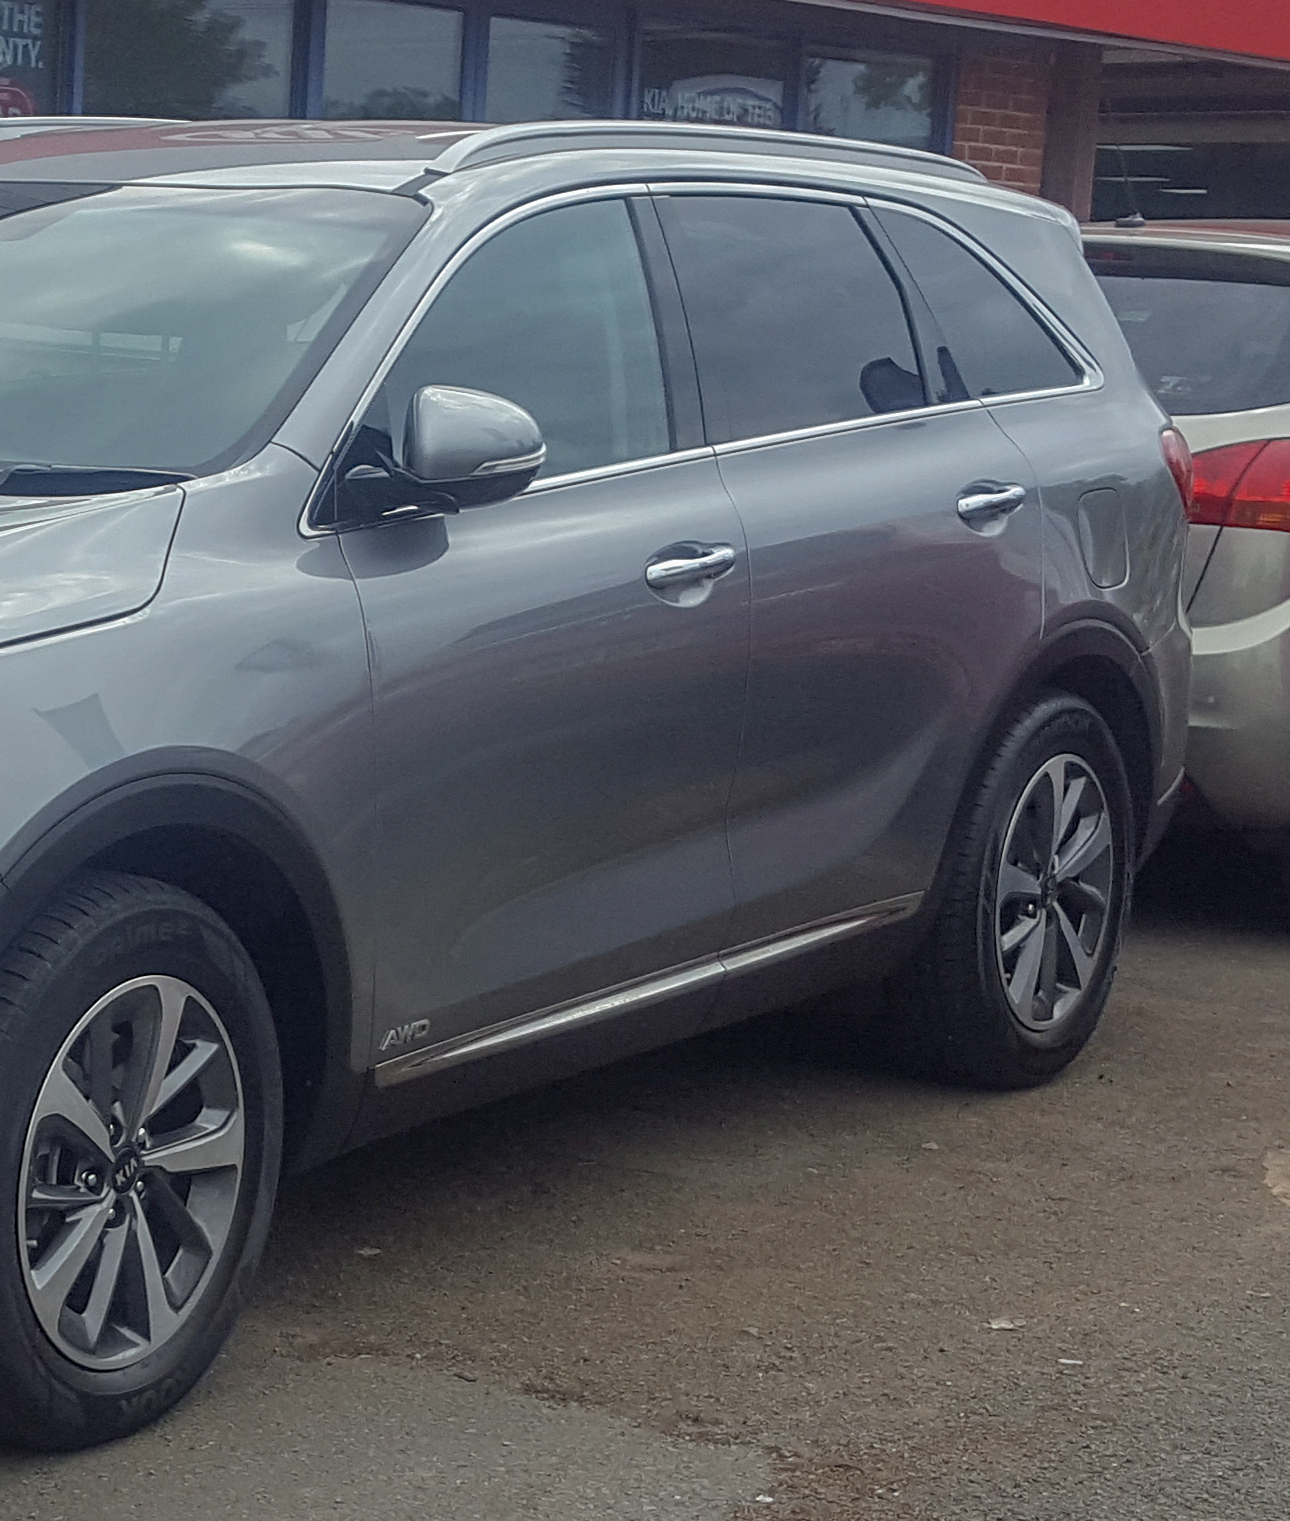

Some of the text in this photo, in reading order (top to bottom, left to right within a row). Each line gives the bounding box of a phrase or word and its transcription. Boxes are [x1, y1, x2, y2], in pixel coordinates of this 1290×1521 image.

[0, 1, 44, 35] THE
[378, 1019, 430, 1051] AWD
[114, 1158, 139, 1187] KIA
